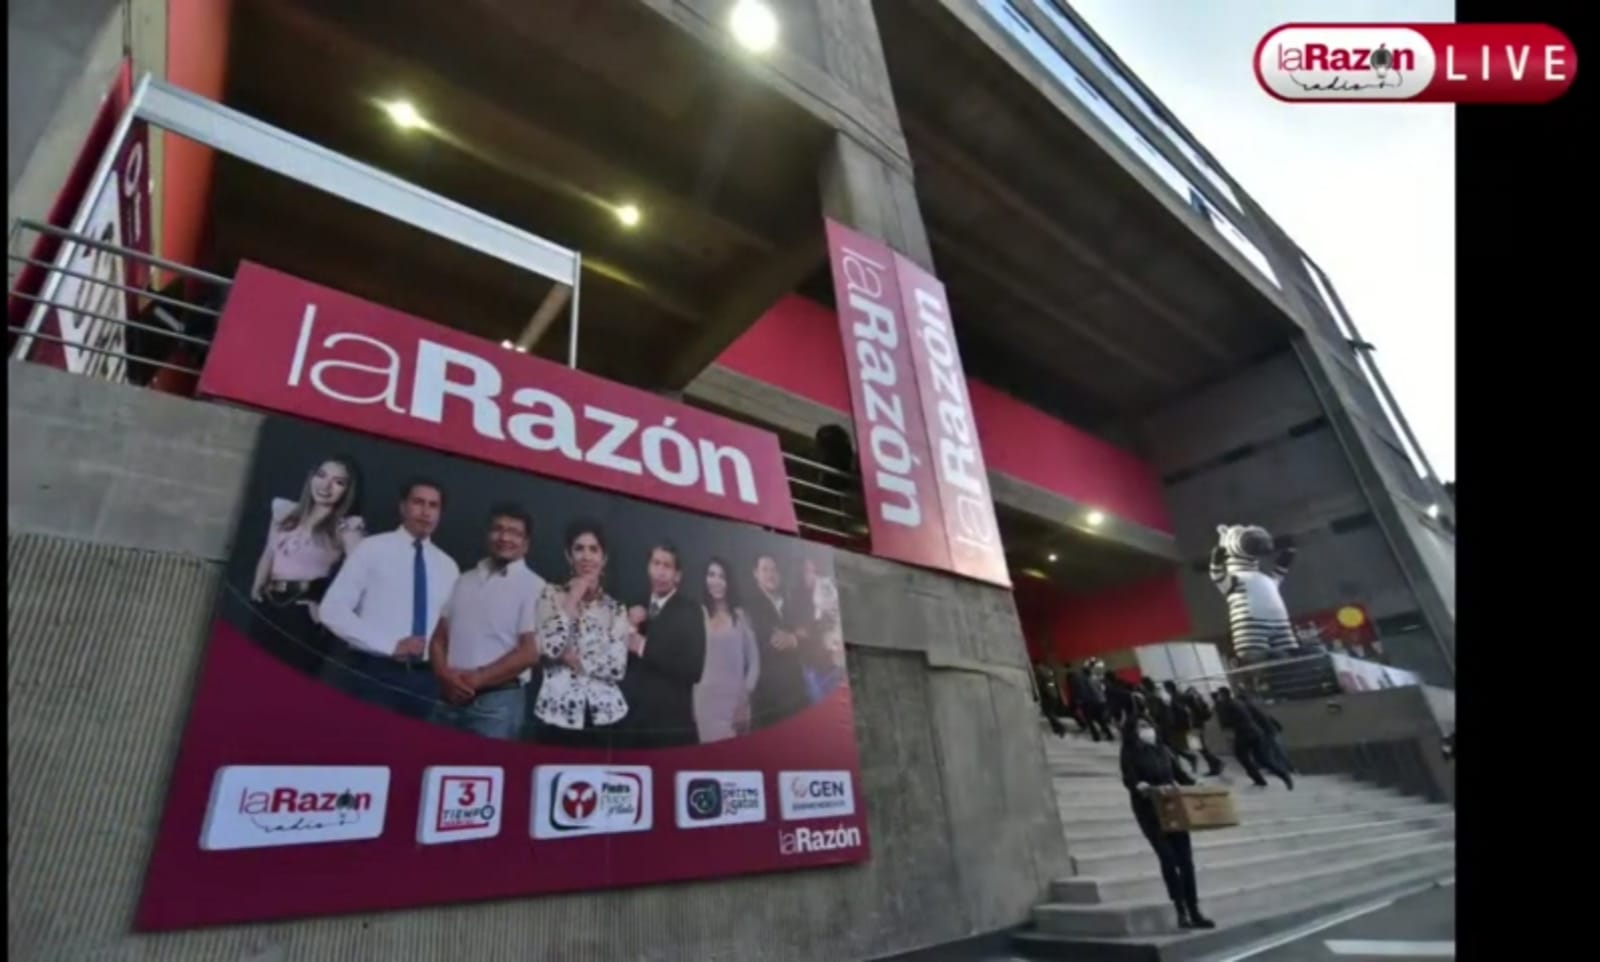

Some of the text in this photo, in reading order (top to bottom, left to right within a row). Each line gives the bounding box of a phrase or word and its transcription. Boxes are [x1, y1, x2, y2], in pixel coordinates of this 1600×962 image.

[287, 303, 759, 505] laRazón
[841, 246, 922, 529] laRazón
[914, 287, 995, 550] laRazón
[458, 782, 475, 806] 3
[779, 824, 861, 855] laRazón
[809, 780, 845, 798] GEN
